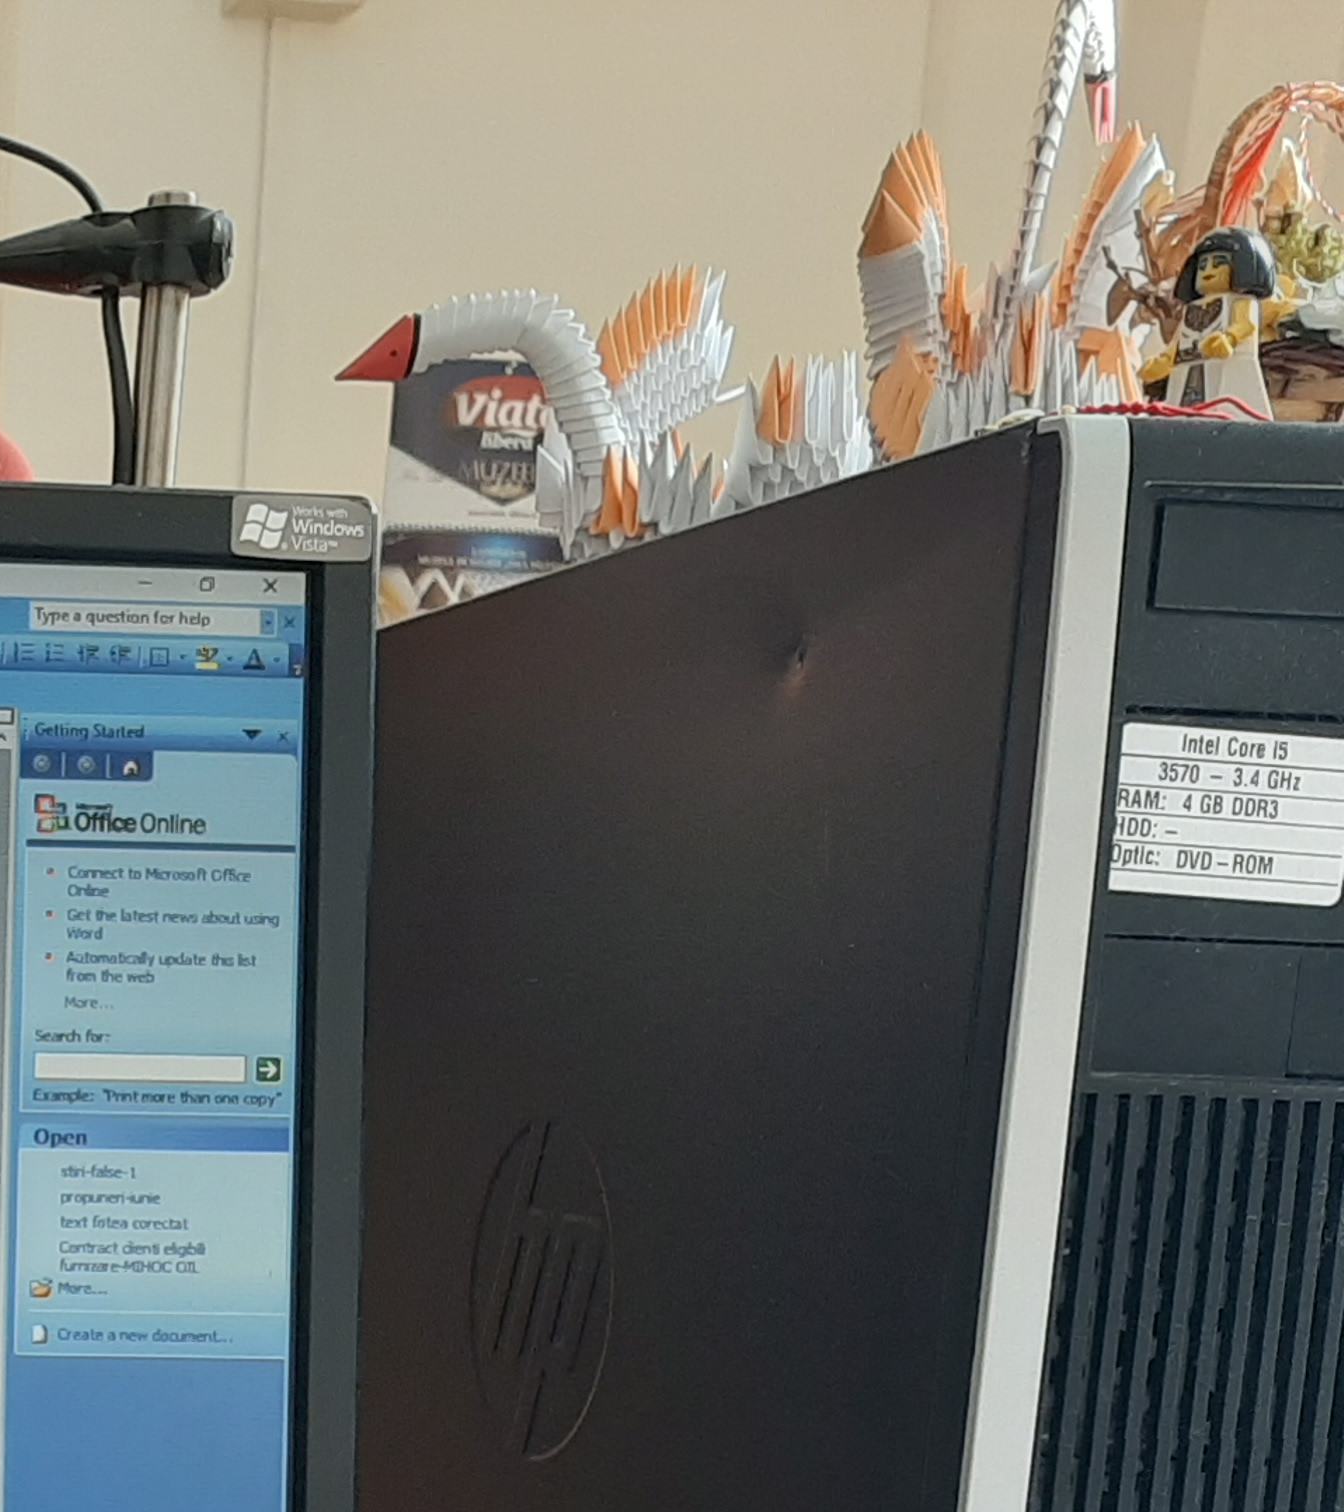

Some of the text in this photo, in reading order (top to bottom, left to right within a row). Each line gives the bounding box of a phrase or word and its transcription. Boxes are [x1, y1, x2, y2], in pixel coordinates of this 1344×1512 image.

[292, 506, 349, 518] Works with
[292, 518, 365, 538] Windows
[34, 607, 211, 629] Type question for help
[35, 723, 145, 740] Getting Started
[1181, 732, 1220, 754] Intel
[1227, 736, 1266, 759] Core
[1158, 761, 1302, 792] 3570 3.4 GHz
[1117, 788, 1280, 820] RAM: 4 GB DDR3
[75, 812, 207, 835] Office Online
[1114, 817, 1158, 839] HDD:
[1111, 844, 1161, 867] Optic:
[68, 866, 252, 883] Connect Microsoft Office
[67, 885, 110, 898] Online
[67, 909, 280, 928] Get the latest news about using
[67, 928, 103, 940] Word
[66, 952, 257, 969] Automatically update this list
[66, 971, 155, 984] from the web
[35, 1030, 111, 1044] Search for:
[33, 1089, 96, 1104] Example:
[140, 1092, 176, 1104] more
[179, 1091, 211, 1105] than
[214, 1094, 240, 1105] one
[243, 1092, 283, 1107] copy"
[34, 1128, 88, 1148] Open
[59, 1241, 119, 1255] Contract
[57, 1329, 105, 1342] Create
[119, 1331, 148, 1342] new
